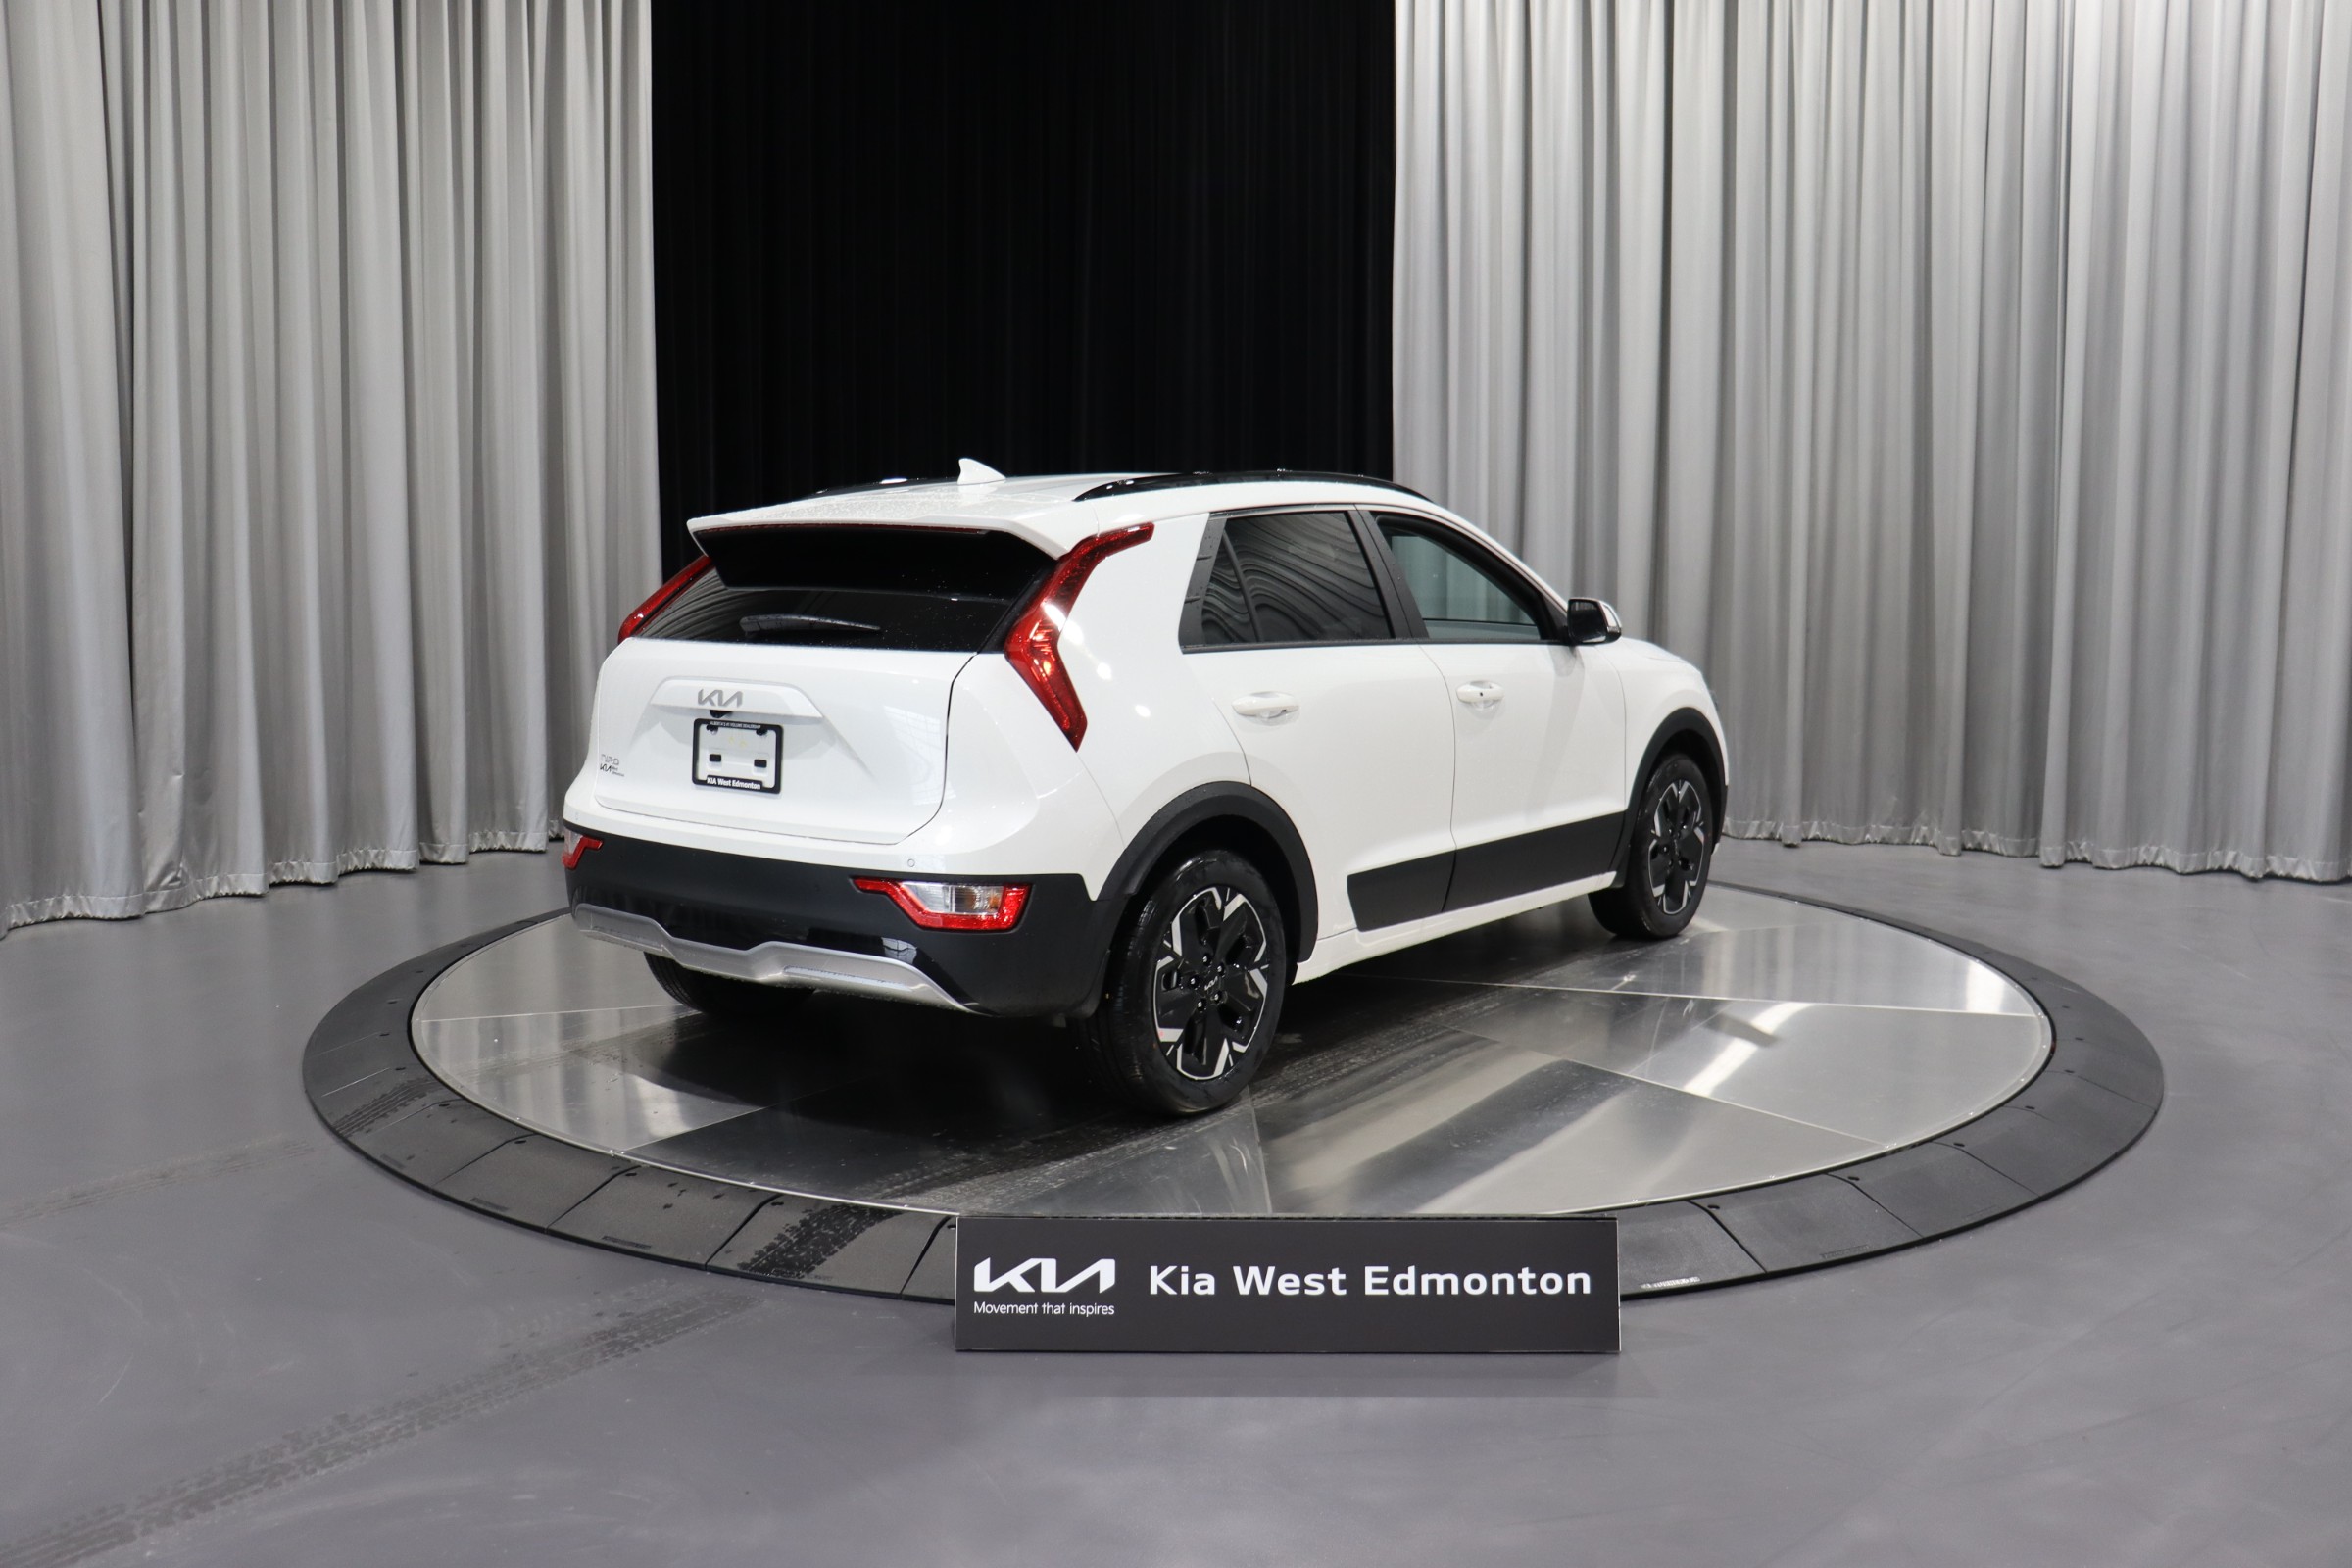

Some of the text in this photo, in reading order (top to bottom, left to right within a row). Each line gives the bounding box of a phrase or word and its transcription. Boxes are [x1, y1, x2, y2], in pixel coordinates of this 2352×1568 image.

[732, 780, 760, 790] Edmonton
[1150, 1265, 1591, 1296] Kia West Edmonton
[974, 1301, 1115, 1318] Movement that inspires
